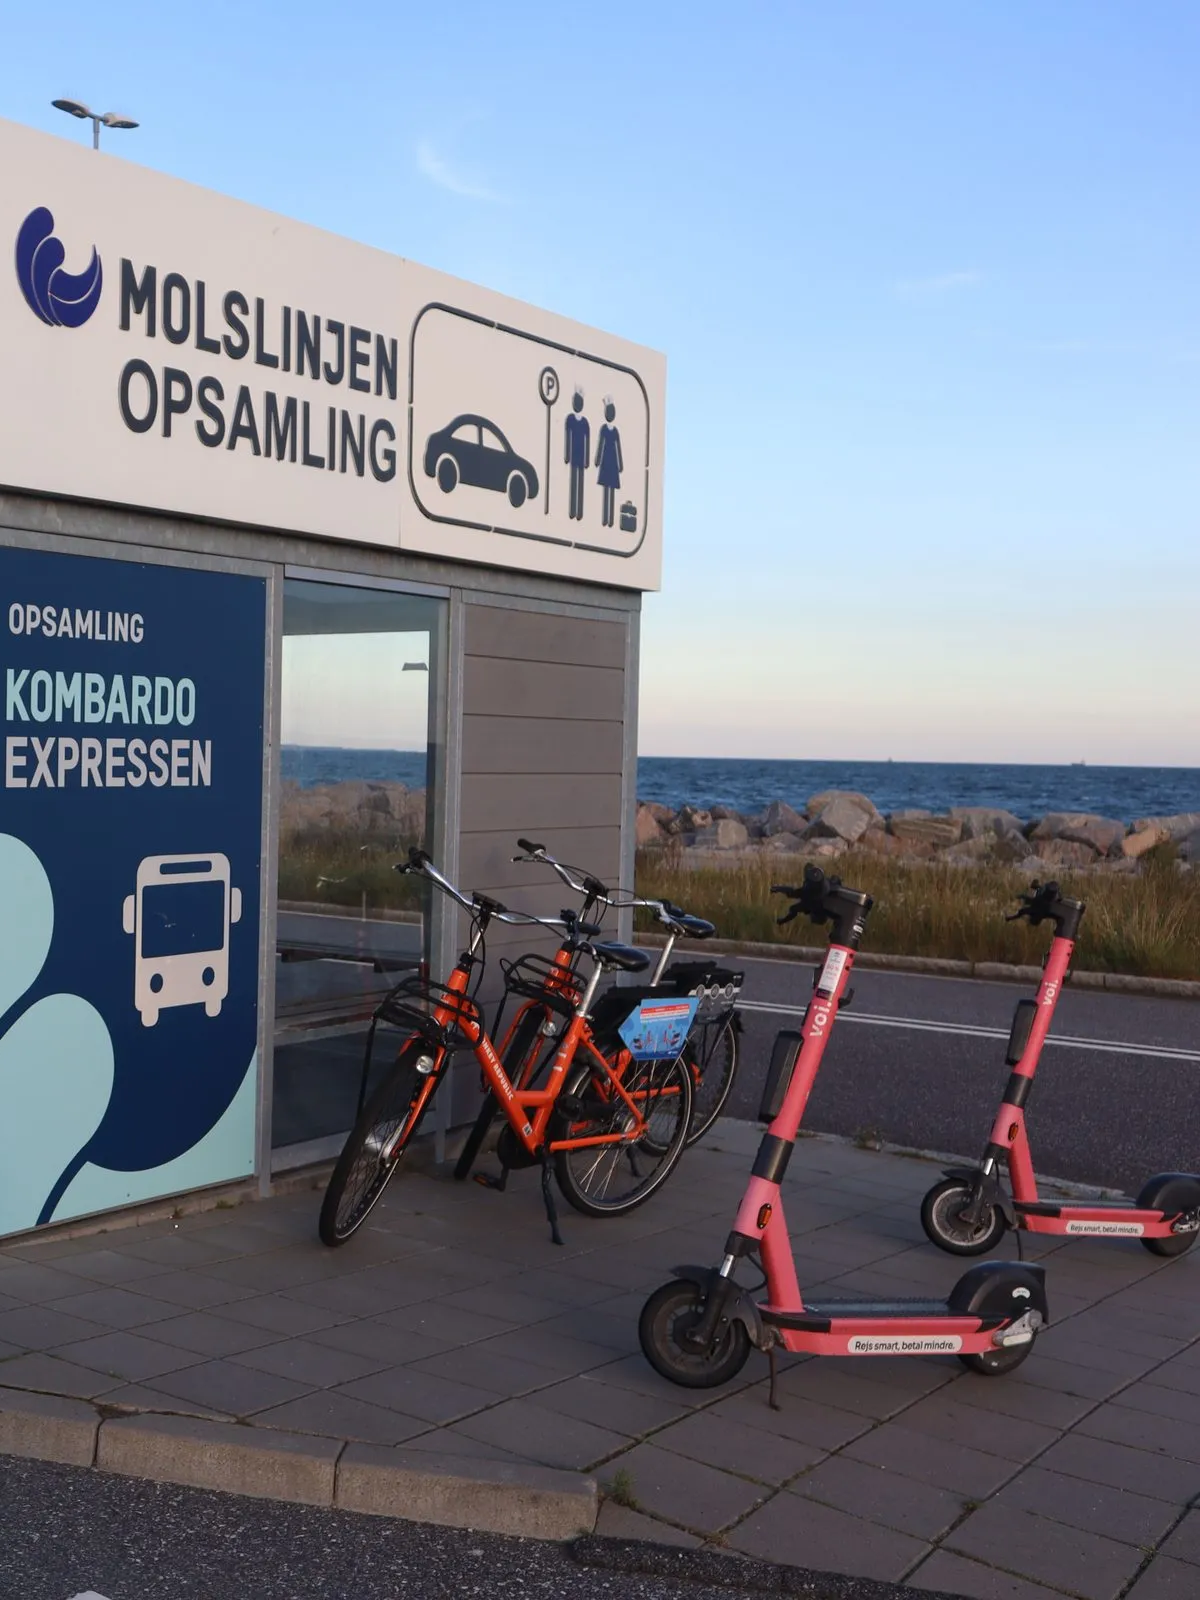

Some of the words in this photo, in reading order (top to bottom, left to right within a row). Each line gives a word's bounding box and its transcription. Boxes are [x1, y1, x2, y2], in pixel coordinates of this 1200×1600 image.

[118, 257, 398, 401] MOLSLINJEN
[545, 376, 555, 396] P
[118, 358, 397, 483] OPSAMLING
[8, 602, 145, 643] OPSAMLING
[5, 668, 196, 726] KOMBARDO
[5, 736, 212, 788] EXPRESSEN
[493, 1063, 514, 1101] REPUBLIC
[1102, 1225, 1117, 1233] betal
[855, 1341, 873, 1352] Rejs
[874, 1342, 901, 1351] smart,
[902, 1341, 923, 1351] betal
[924, 1341, 955, 1351] mindre.
